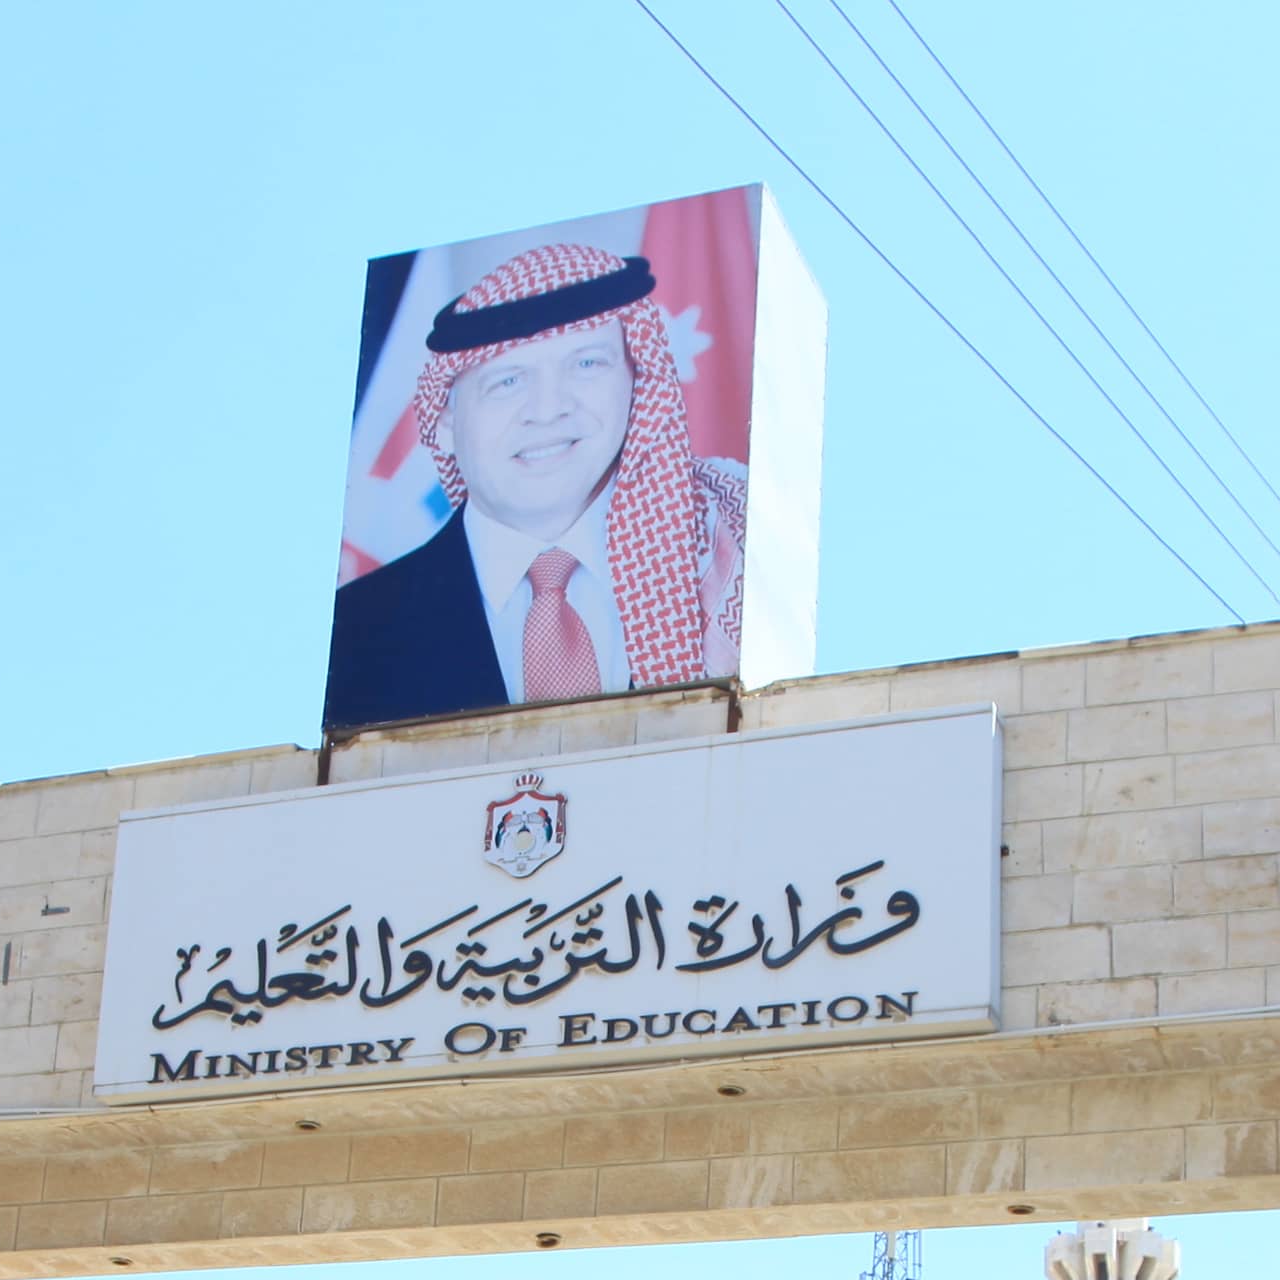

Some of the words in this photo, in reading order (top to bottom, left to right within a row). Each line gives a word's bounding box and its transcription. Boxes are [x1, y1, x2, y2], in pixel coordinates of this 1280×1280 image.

[152, 905, 440, 1030] والتعليم
[436, 876, 664, 1005] التربية
[675, 860, 921, 972] وزارة
[443, 1022, 528, 1056] OF
